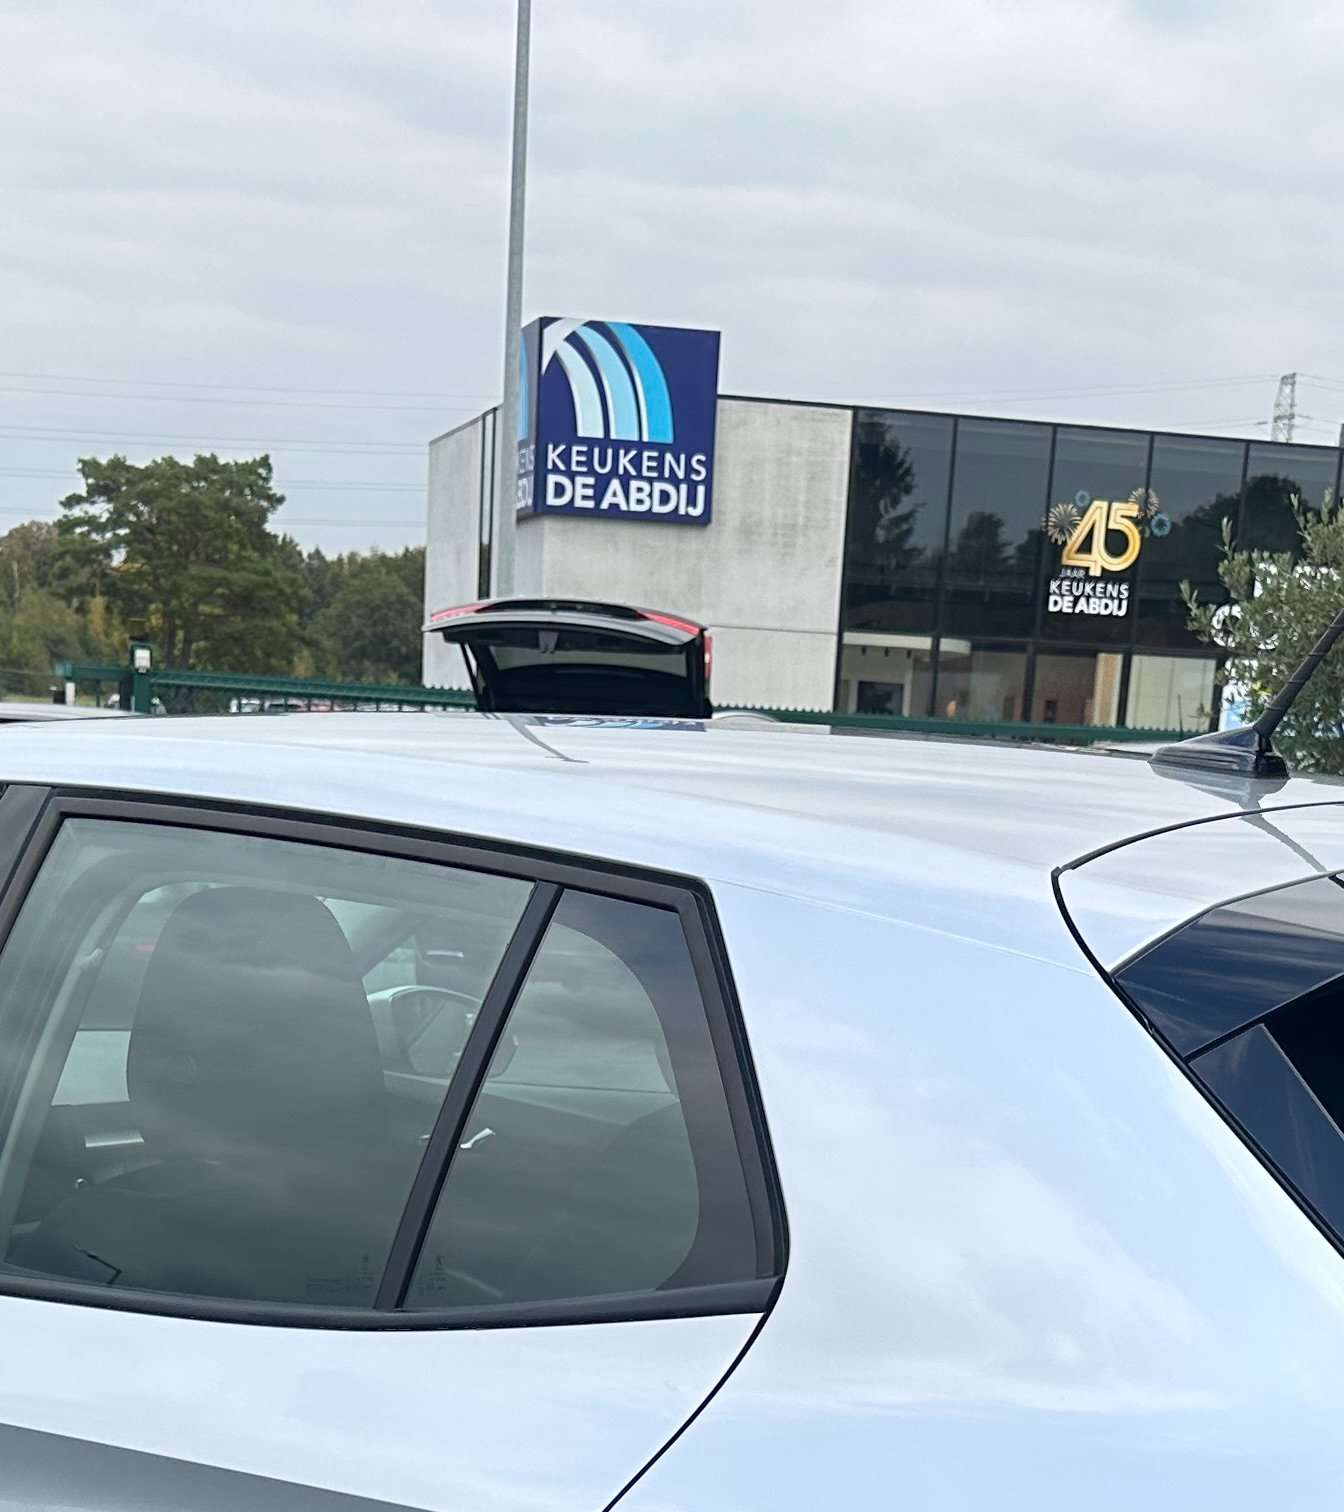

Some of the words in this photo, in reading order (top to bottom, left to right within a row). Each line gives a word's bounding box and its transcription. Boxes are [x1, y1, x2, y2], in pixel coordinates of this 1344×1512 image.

[546, 443, 707, 481] KEUKENS
[545, 473, 595, 509] DE
[599, 477, 706, 517] ABDIJ
[1061, 499, 1141, 577] 45
[1047, 594, 1074, 614] DE
[1074, 597, 1128, 617] ABDIJ
[1049, 579, 1129, 599] KEUKENS
